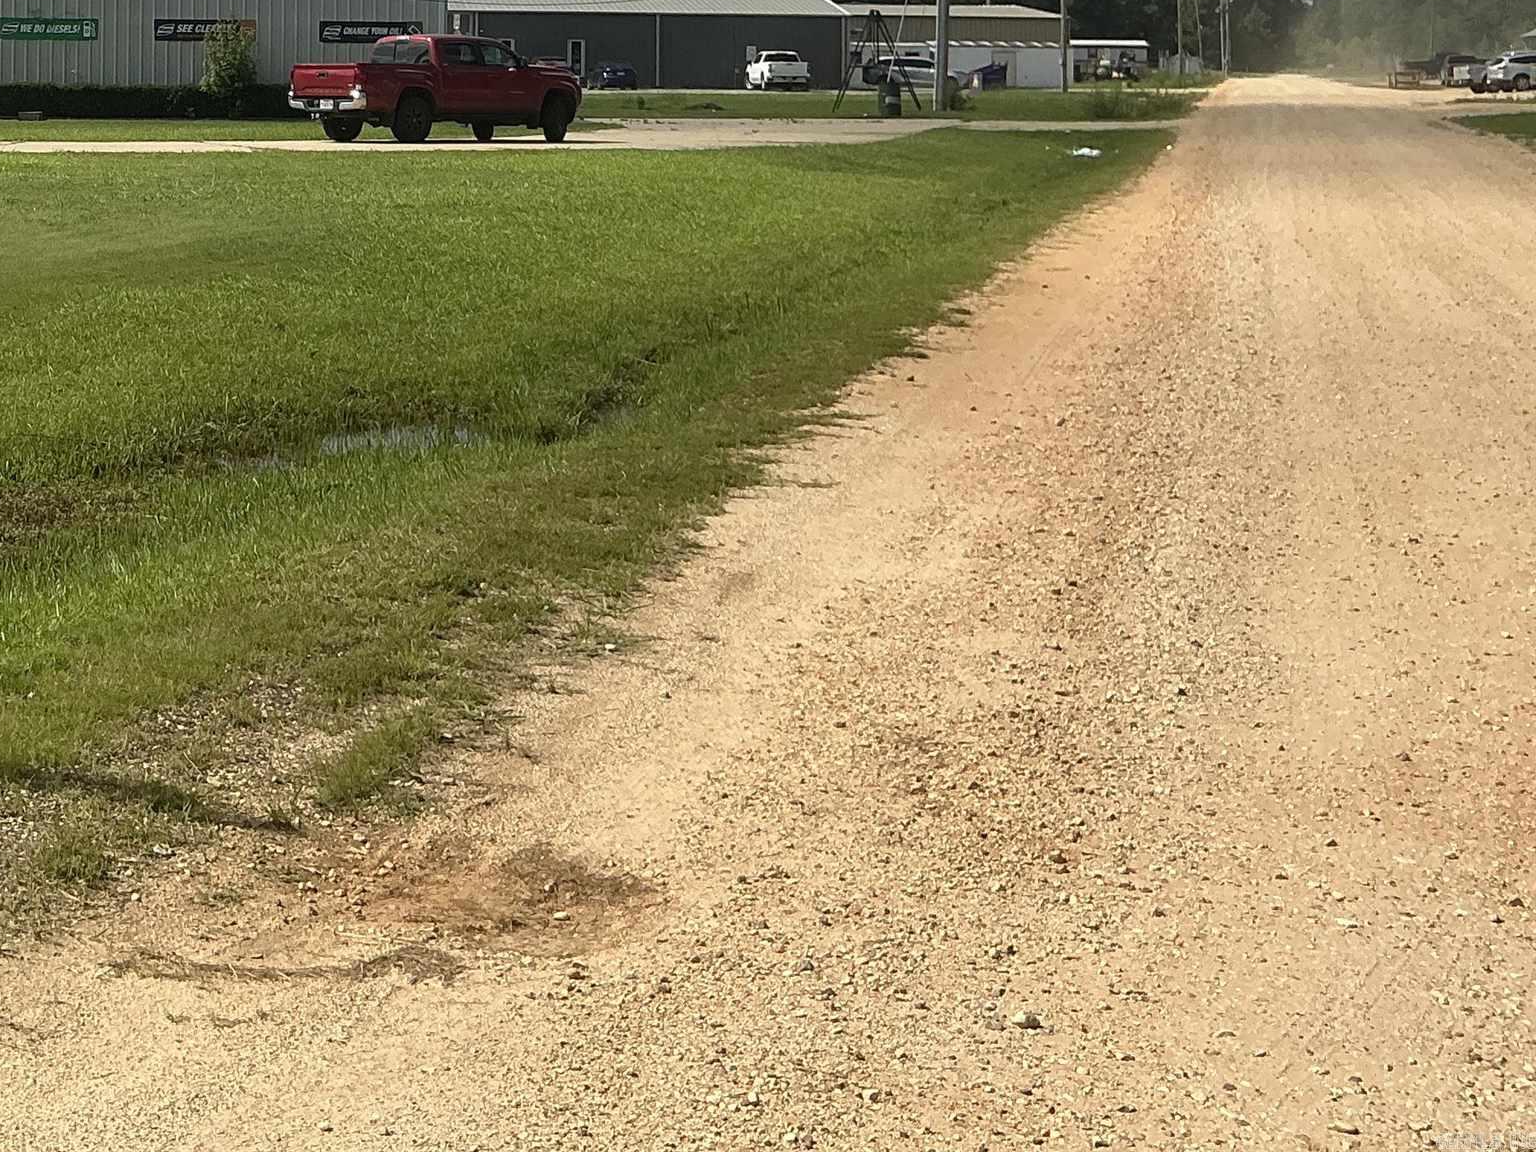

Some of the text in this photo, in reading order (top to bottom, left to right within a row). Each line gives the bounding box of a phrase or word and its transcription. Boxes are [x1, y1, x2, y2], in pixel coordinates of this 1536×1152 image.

[20, 24, 32, 33] WE
[34, 24, 45, 33] DO
[176, 24, 194, 33] SEE
[343, 27, 370, 35] CHANGE
